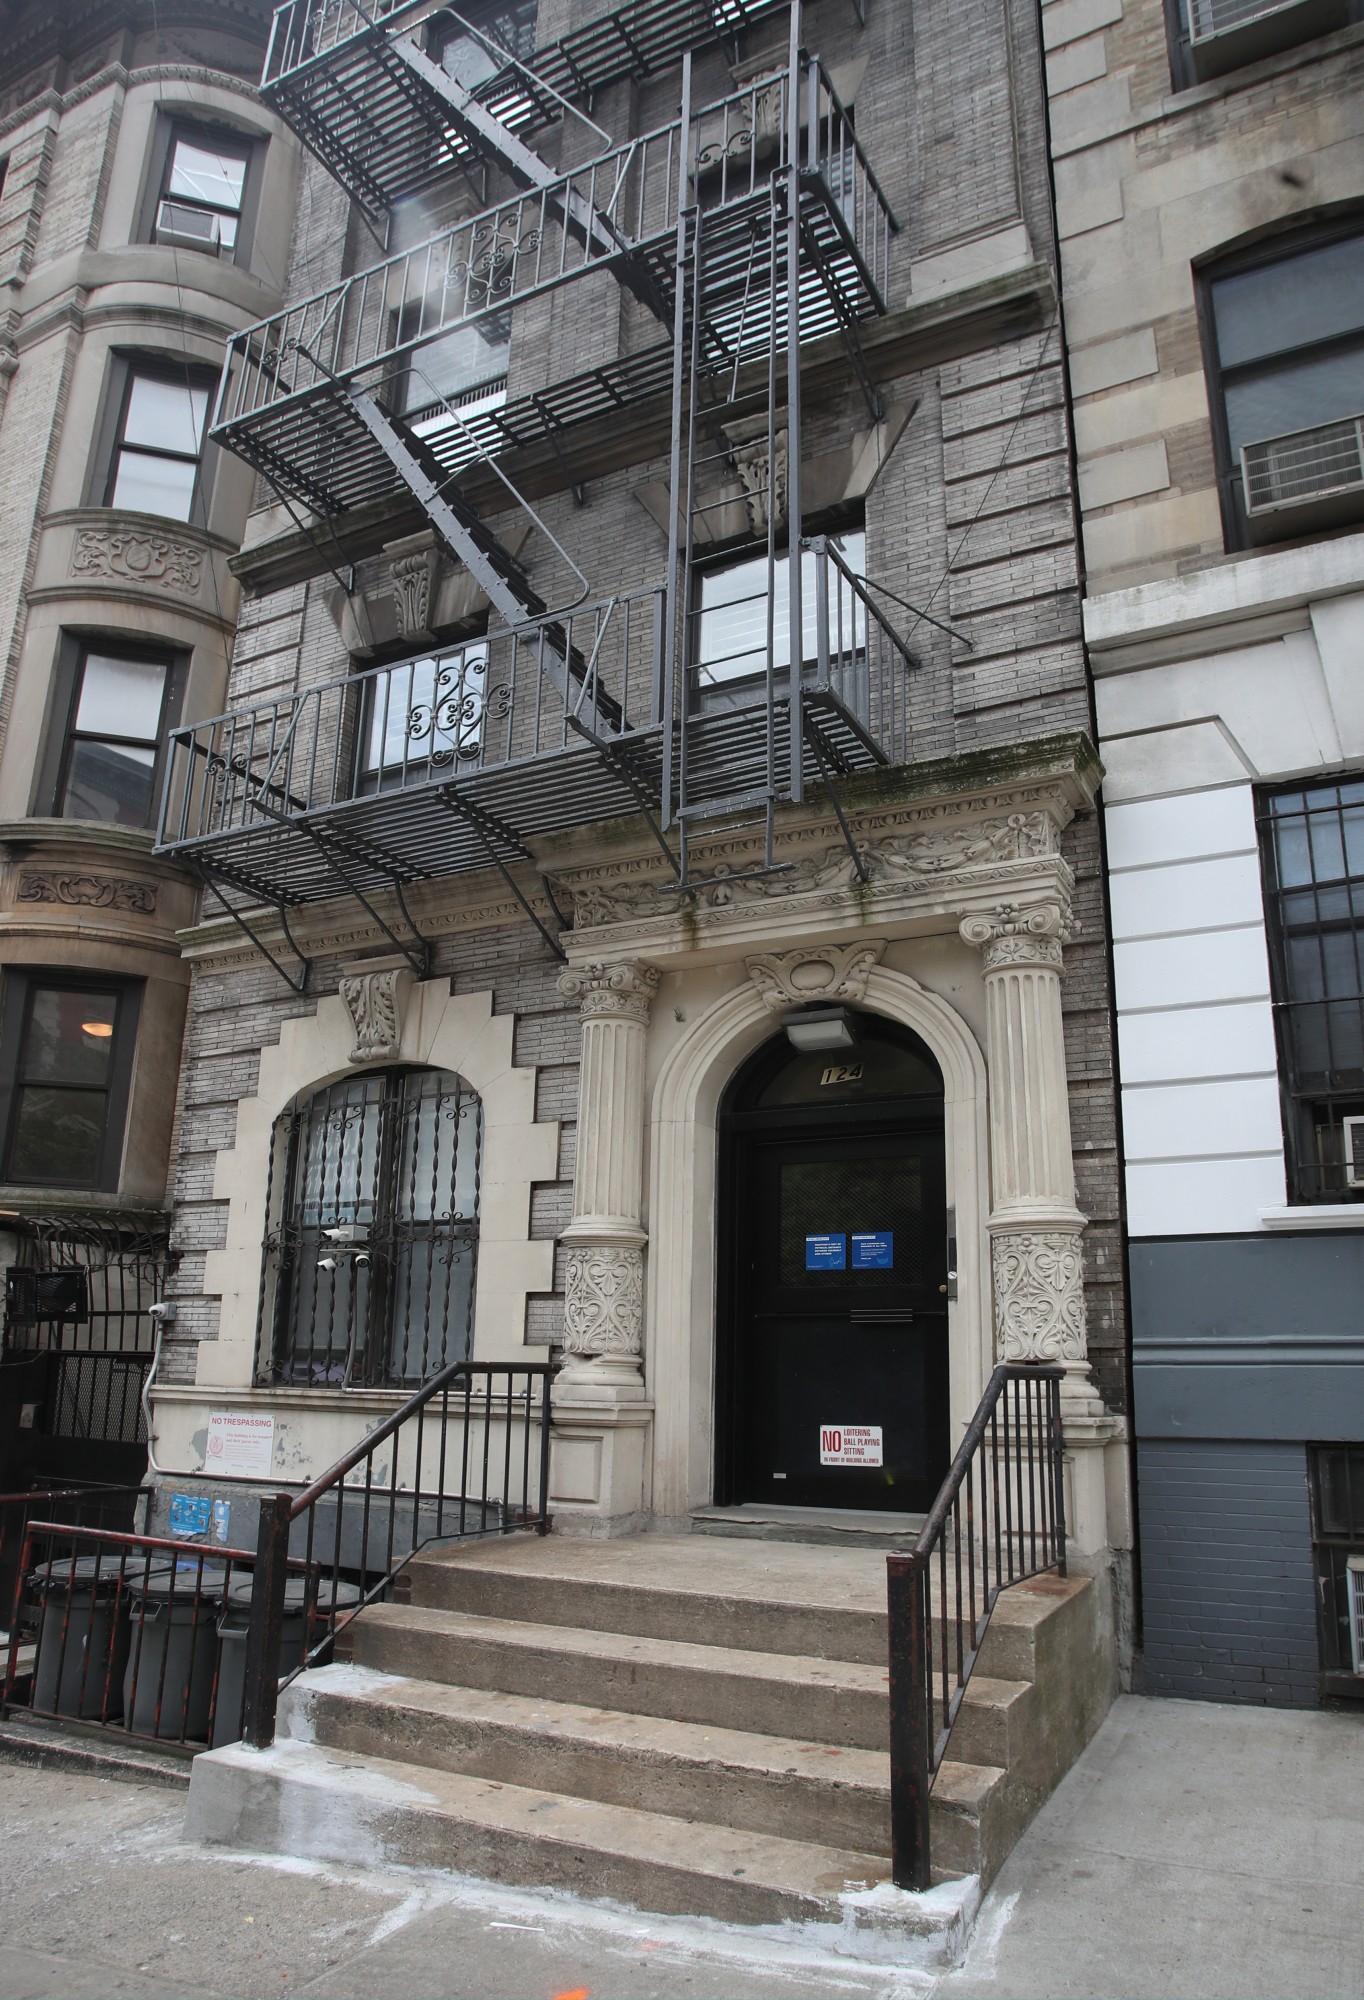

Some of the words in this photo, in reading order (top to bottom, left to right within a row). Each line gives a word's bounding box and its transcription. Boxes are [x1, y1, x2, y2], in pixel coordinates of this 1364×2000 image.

[825, 1063, 862, 1083] 124
[211, 1417, 222, 1425] NO
[223, 1418, 272, 1428] TRESPASSING
[843, 1428, 871, 1437] LOITERING
[822, 1430, 842, 1453] NO
[843, 1437, 857, 1446] BALL
[857, 1438, 880, 1447] PLAYING
[843, 1447, 865, 1456] SITTING
